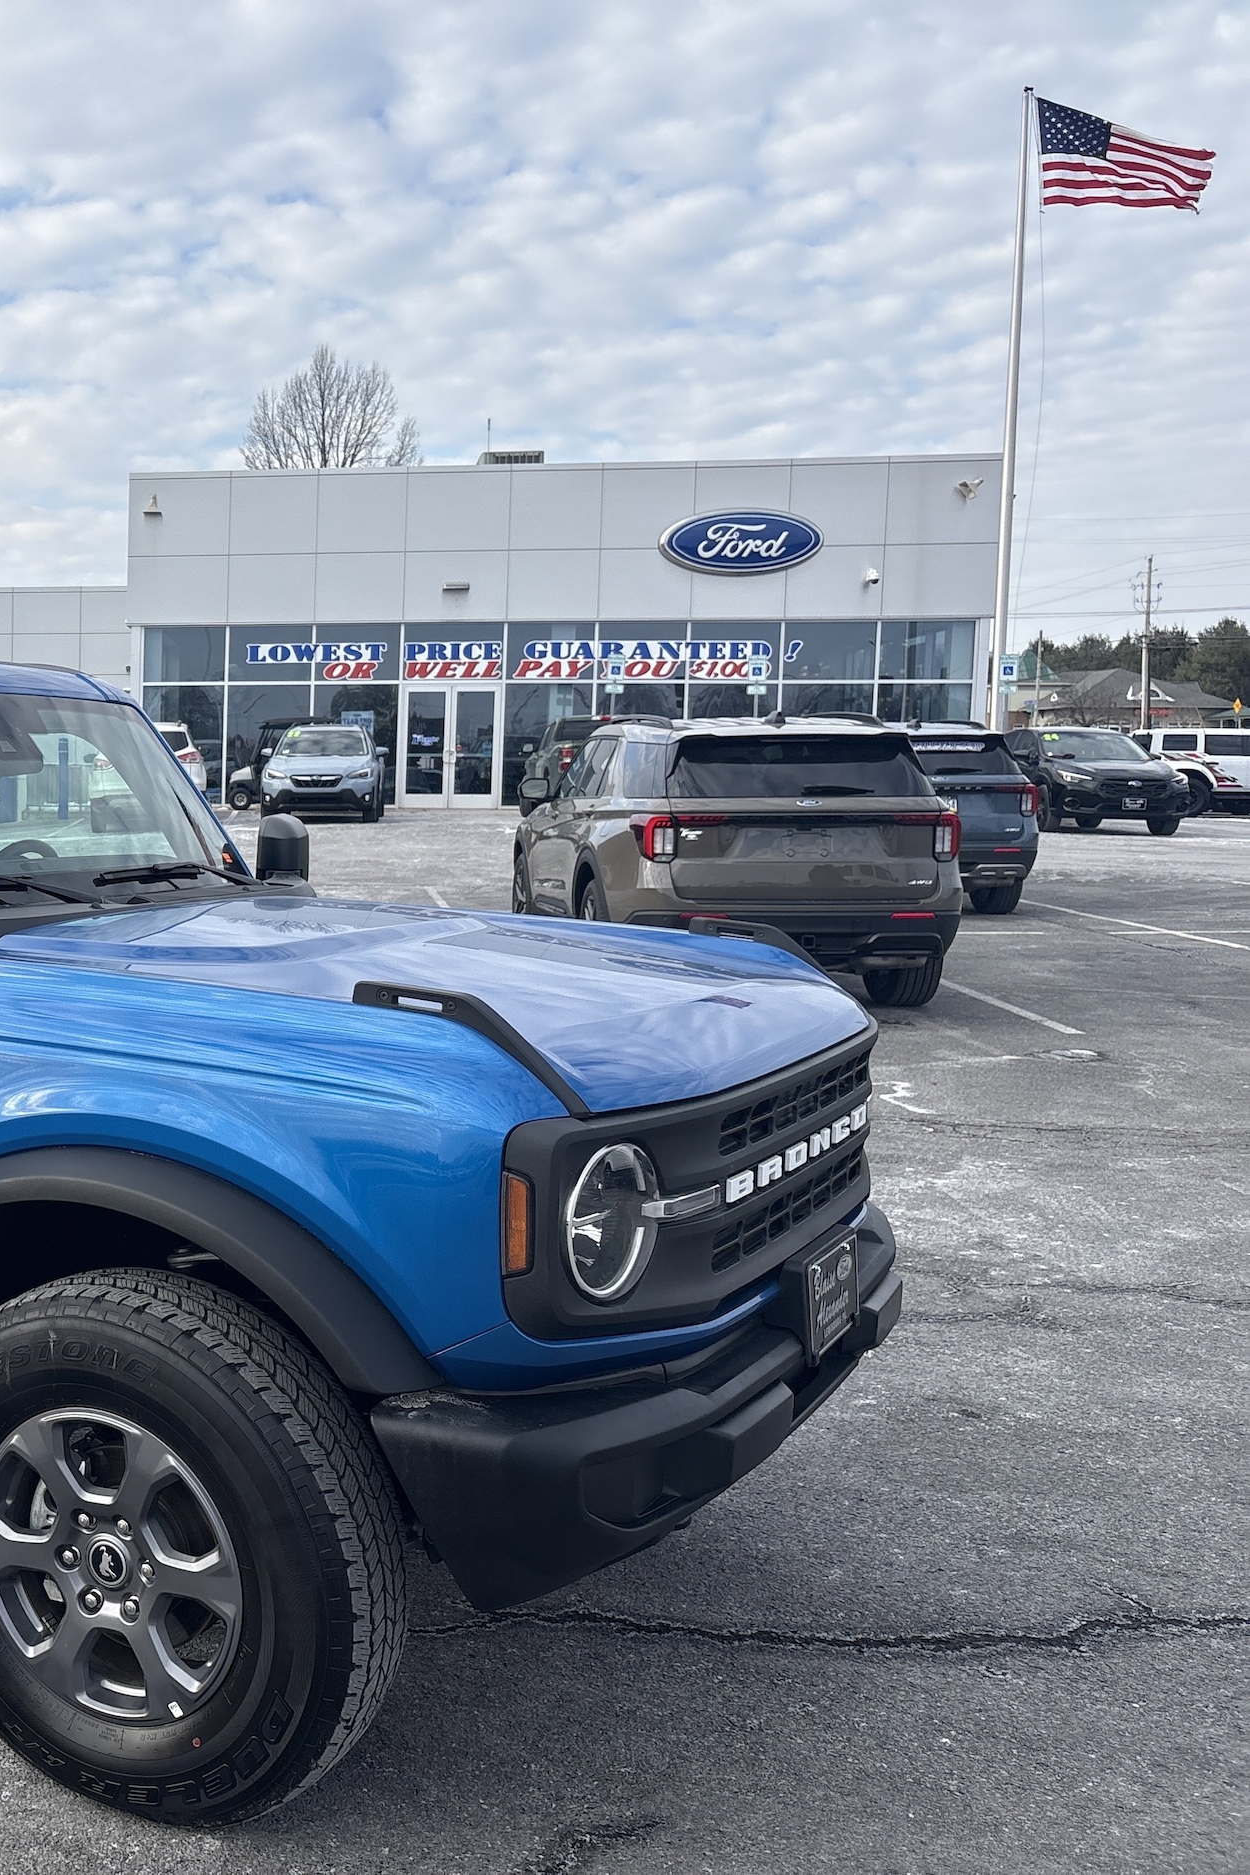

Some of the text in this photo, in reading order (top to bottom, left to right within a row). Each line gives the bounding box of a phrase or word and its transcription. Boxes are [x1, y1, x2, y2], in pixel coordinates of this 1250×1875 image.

[696, 522, 790, 559] Ford
[247, 643, 387, 663] LOWEST
[405, 642, 502, 661] PRICE
[523, 640, 772, 660] GUARANTEED
[324, 662, 377, 679] OR
[514, 660, 591, 679] PAY
[689, 660, 772, 679] $1,00
[725, 1103, 867, 1203] BRONCO
[2, 1720, 66, 1768] A/T
[79, 1690, 295, 1805] DUELER
